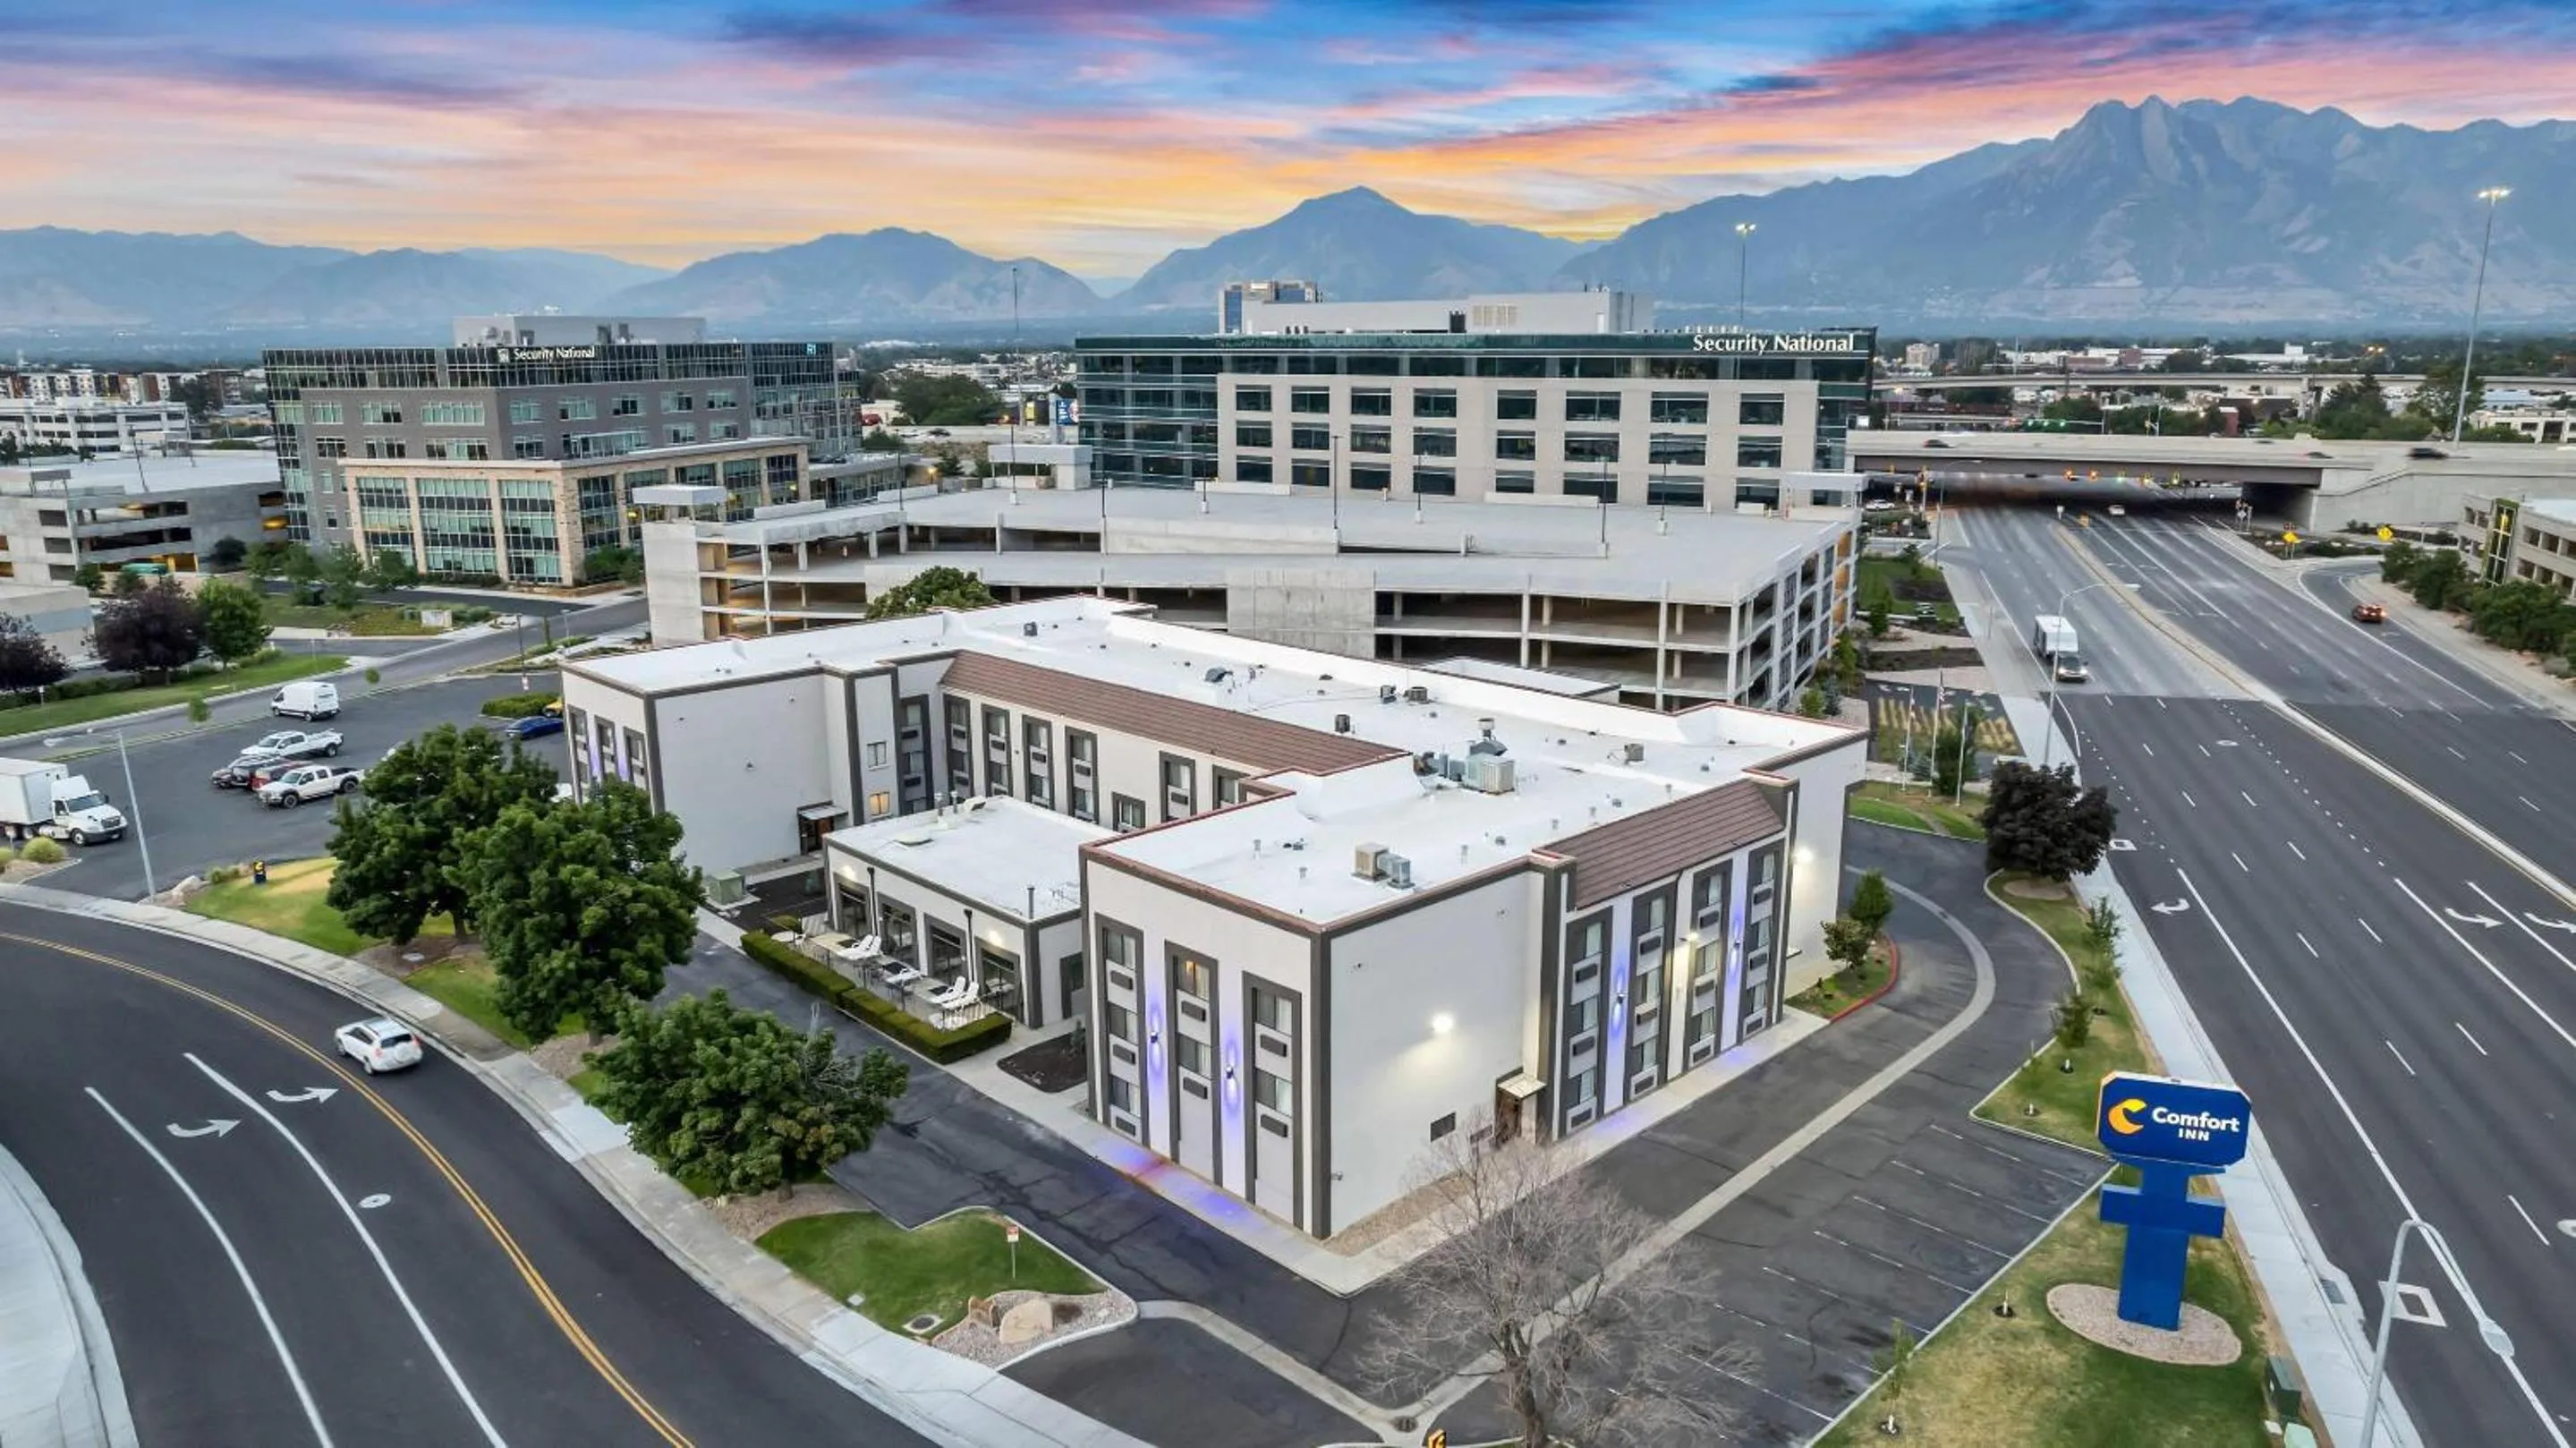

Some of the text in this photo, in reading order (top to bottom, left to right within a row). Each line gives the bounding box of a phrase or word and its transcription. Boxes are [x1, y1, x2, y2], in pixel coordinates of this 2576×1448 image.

[514, 345, 595, 363] Security National
[1693, 334, 1854, 355] Security National
[2152, 1107, 2240, 1133] Comfort
[2178, 1129, 2210, 1141] INN
